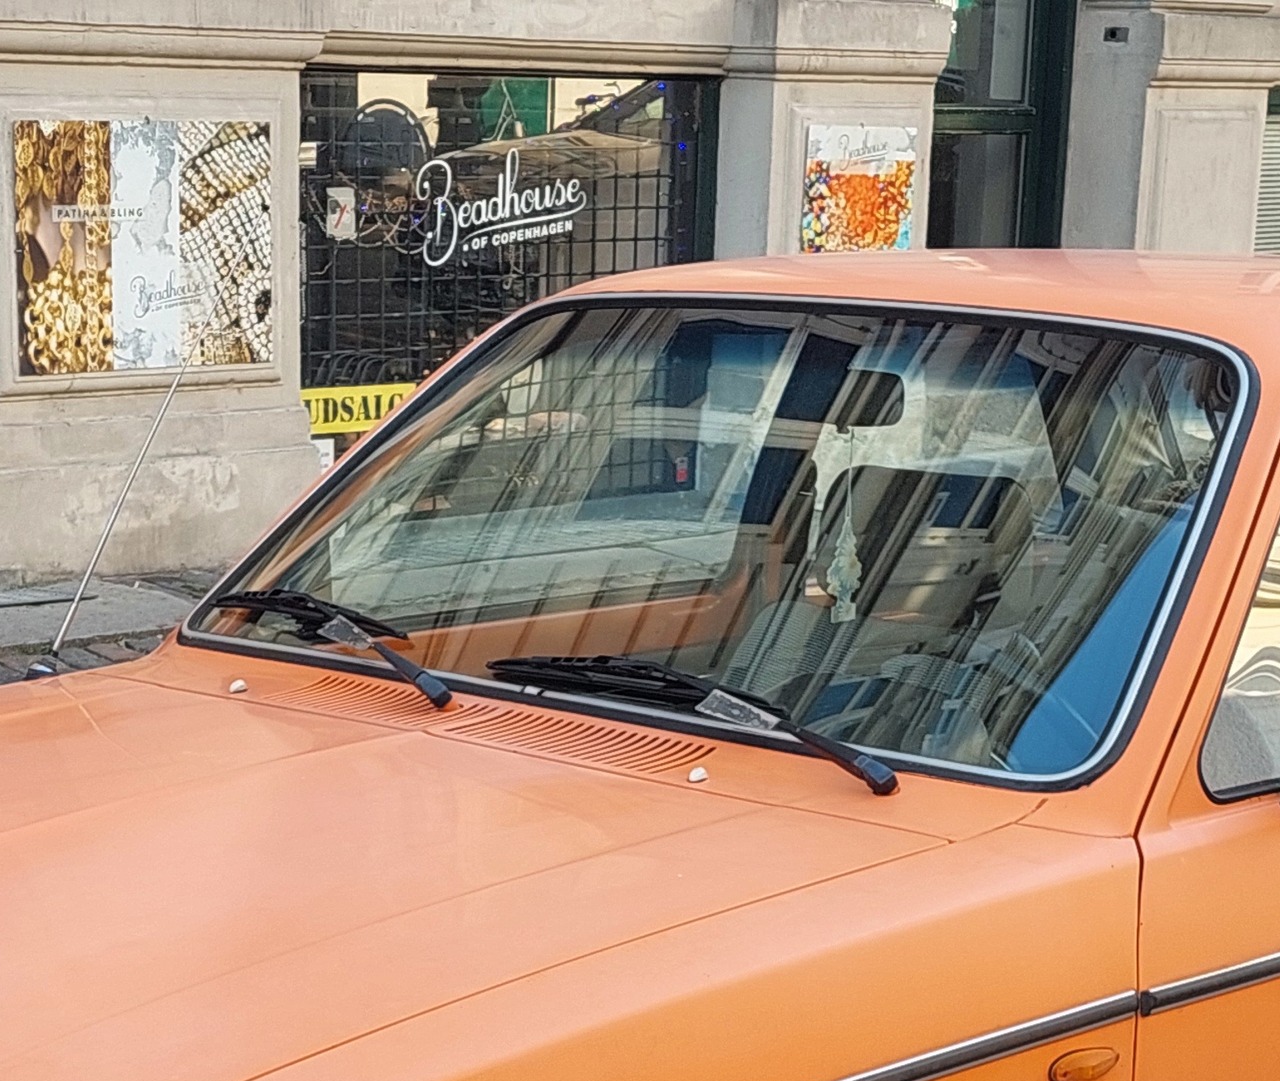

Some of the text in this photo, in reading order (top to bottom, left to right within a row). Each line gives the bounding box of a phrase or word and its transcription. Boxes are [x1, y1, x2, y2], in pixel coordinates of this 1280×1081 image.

[57, 208, 97, 218] PATINA
[110, 207, 143, 217] BLING
[416, 148, 587, 267] Beadhouse
[472, 220, 573, 250] OF COPENHAGEN
[130, 270, 207, 319] Beadhouse
